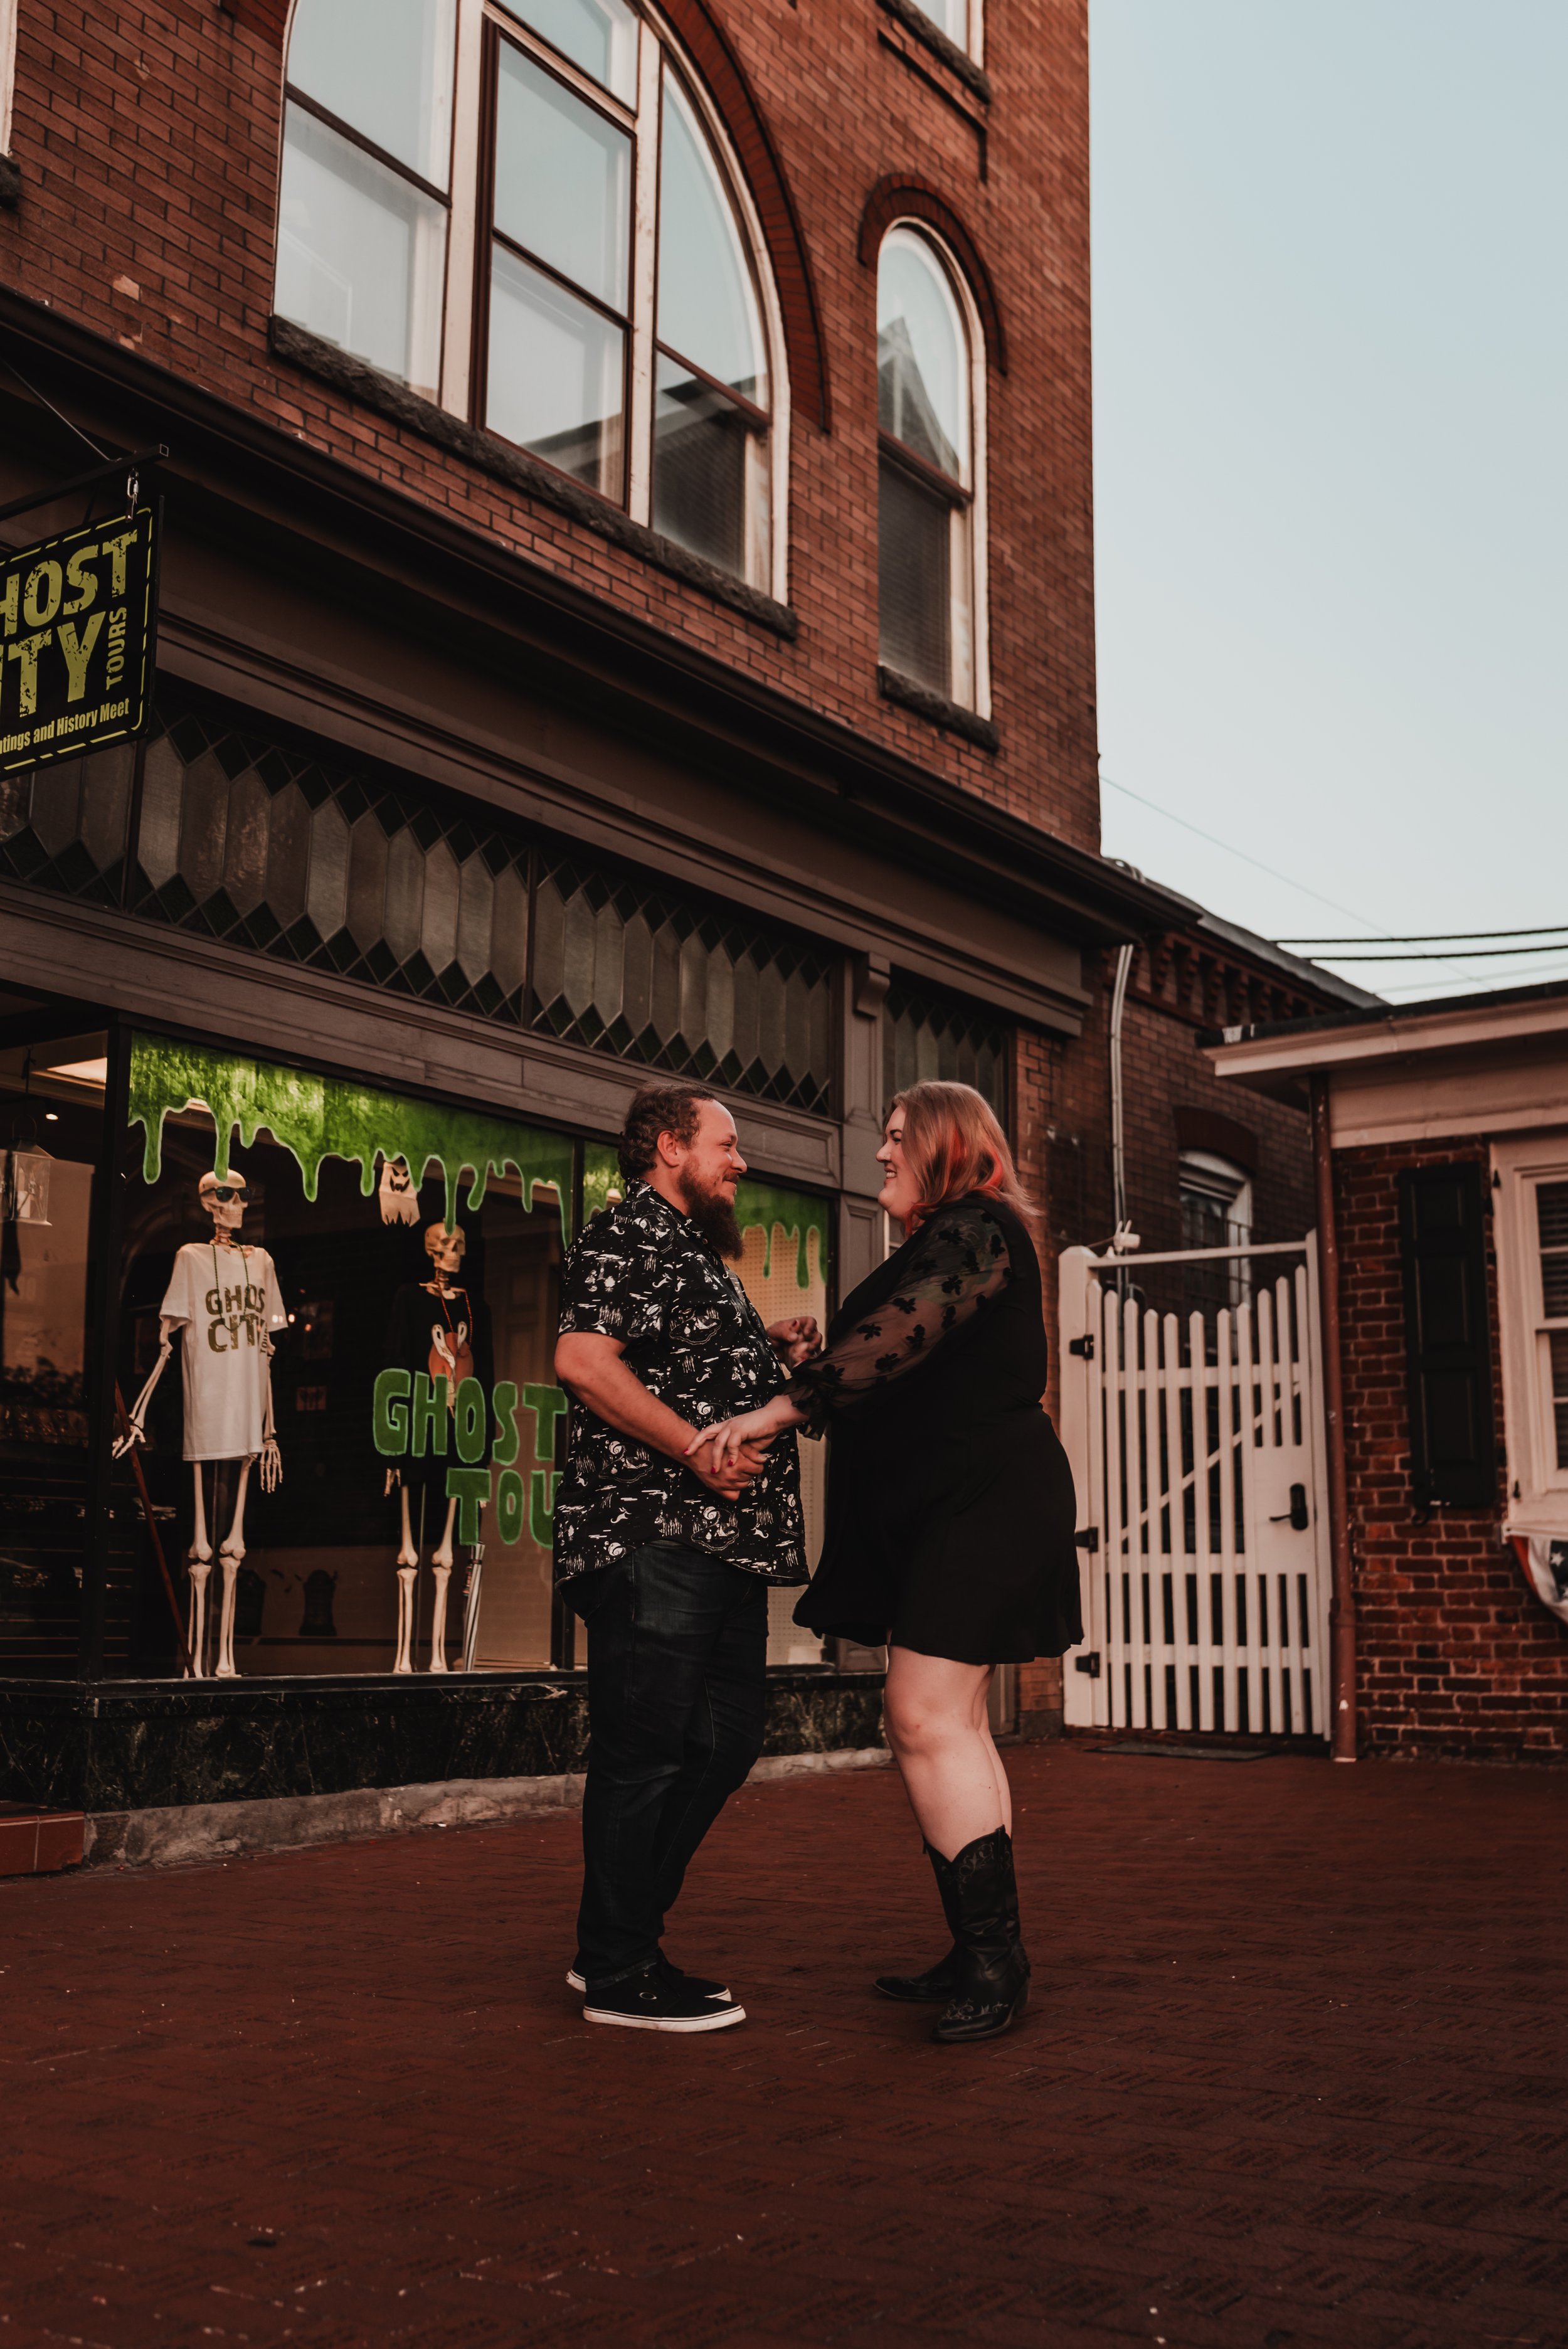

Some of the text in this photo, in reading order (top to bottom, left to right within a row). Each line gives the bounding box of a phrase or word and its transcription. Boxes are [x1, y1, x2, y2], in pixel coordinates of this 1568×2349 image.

[0, 611, 106, 718] TY
[106, 607, 127, 691] TOURS
[33, 721, 55, 744] and
[56, 709, 98, 736] History
[100, 697, 130, 723] Meet
[373, 1367, 568, 1466] GHOST
